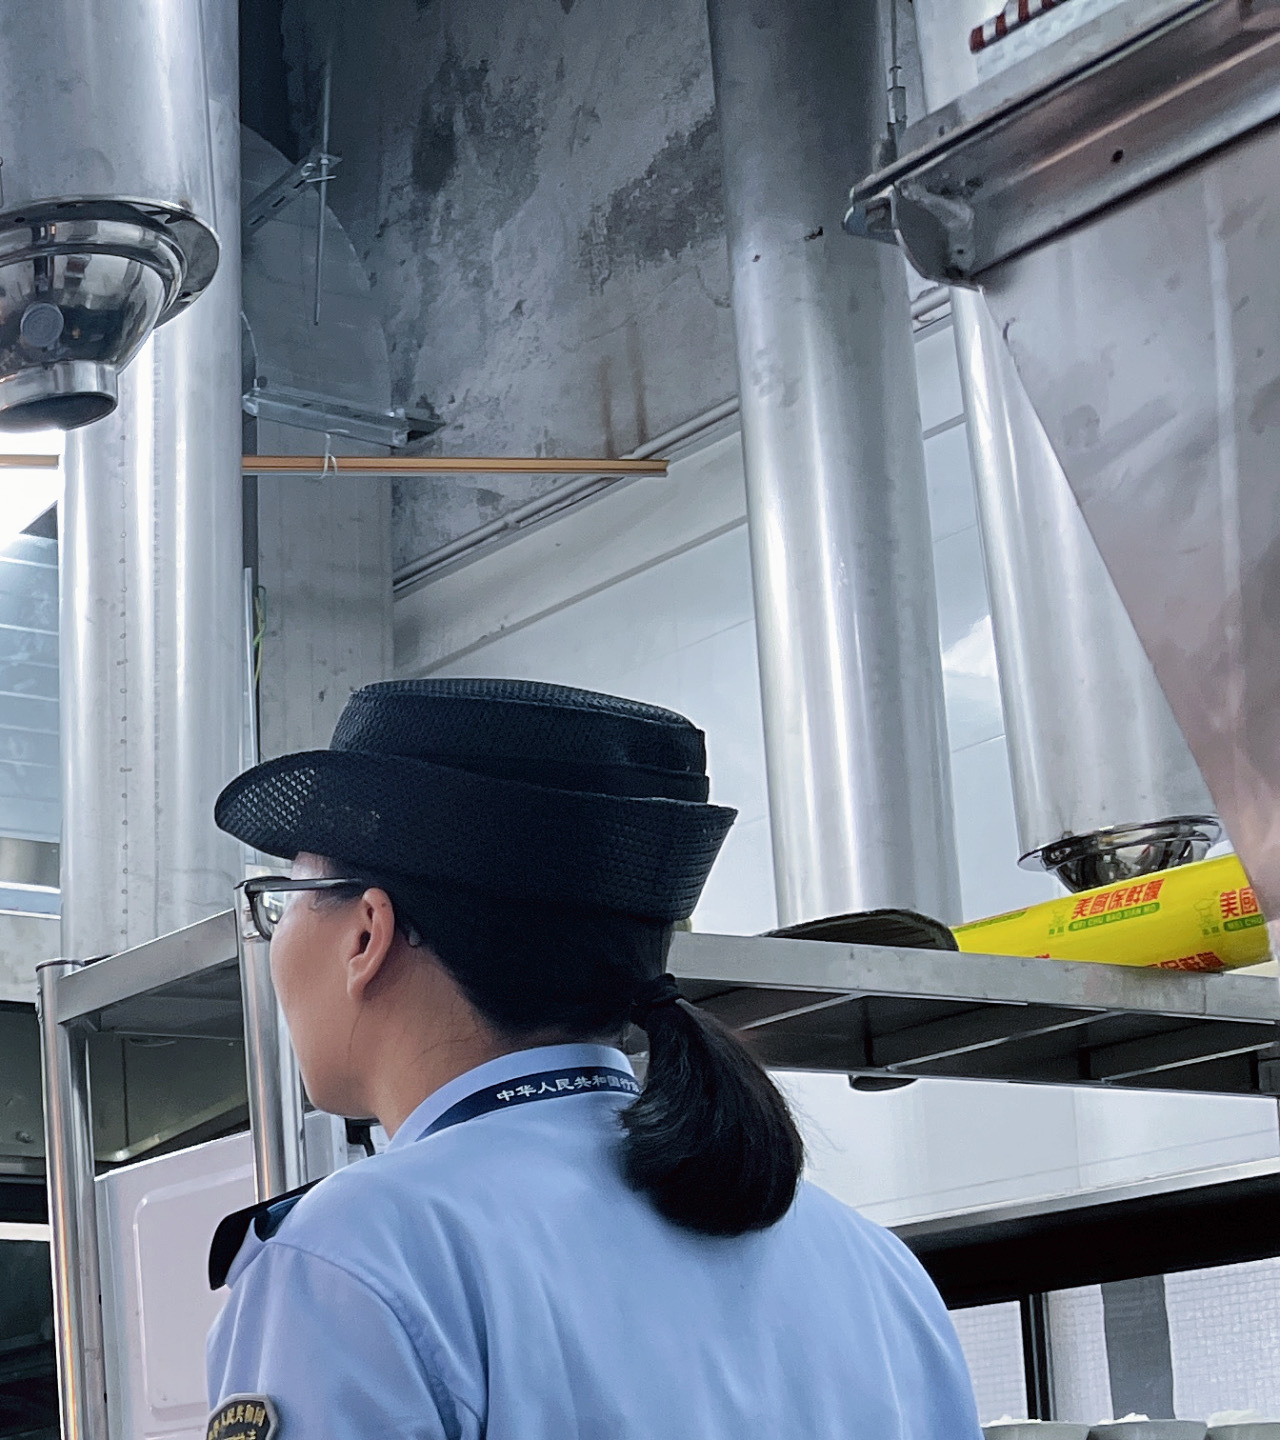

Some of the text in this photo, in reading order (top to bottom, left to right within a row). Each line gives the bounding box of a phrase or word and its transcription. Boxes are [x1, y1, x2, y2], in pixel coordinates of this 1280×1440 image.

[1071, 878, 1165, 920] 美厨保鲜膜
